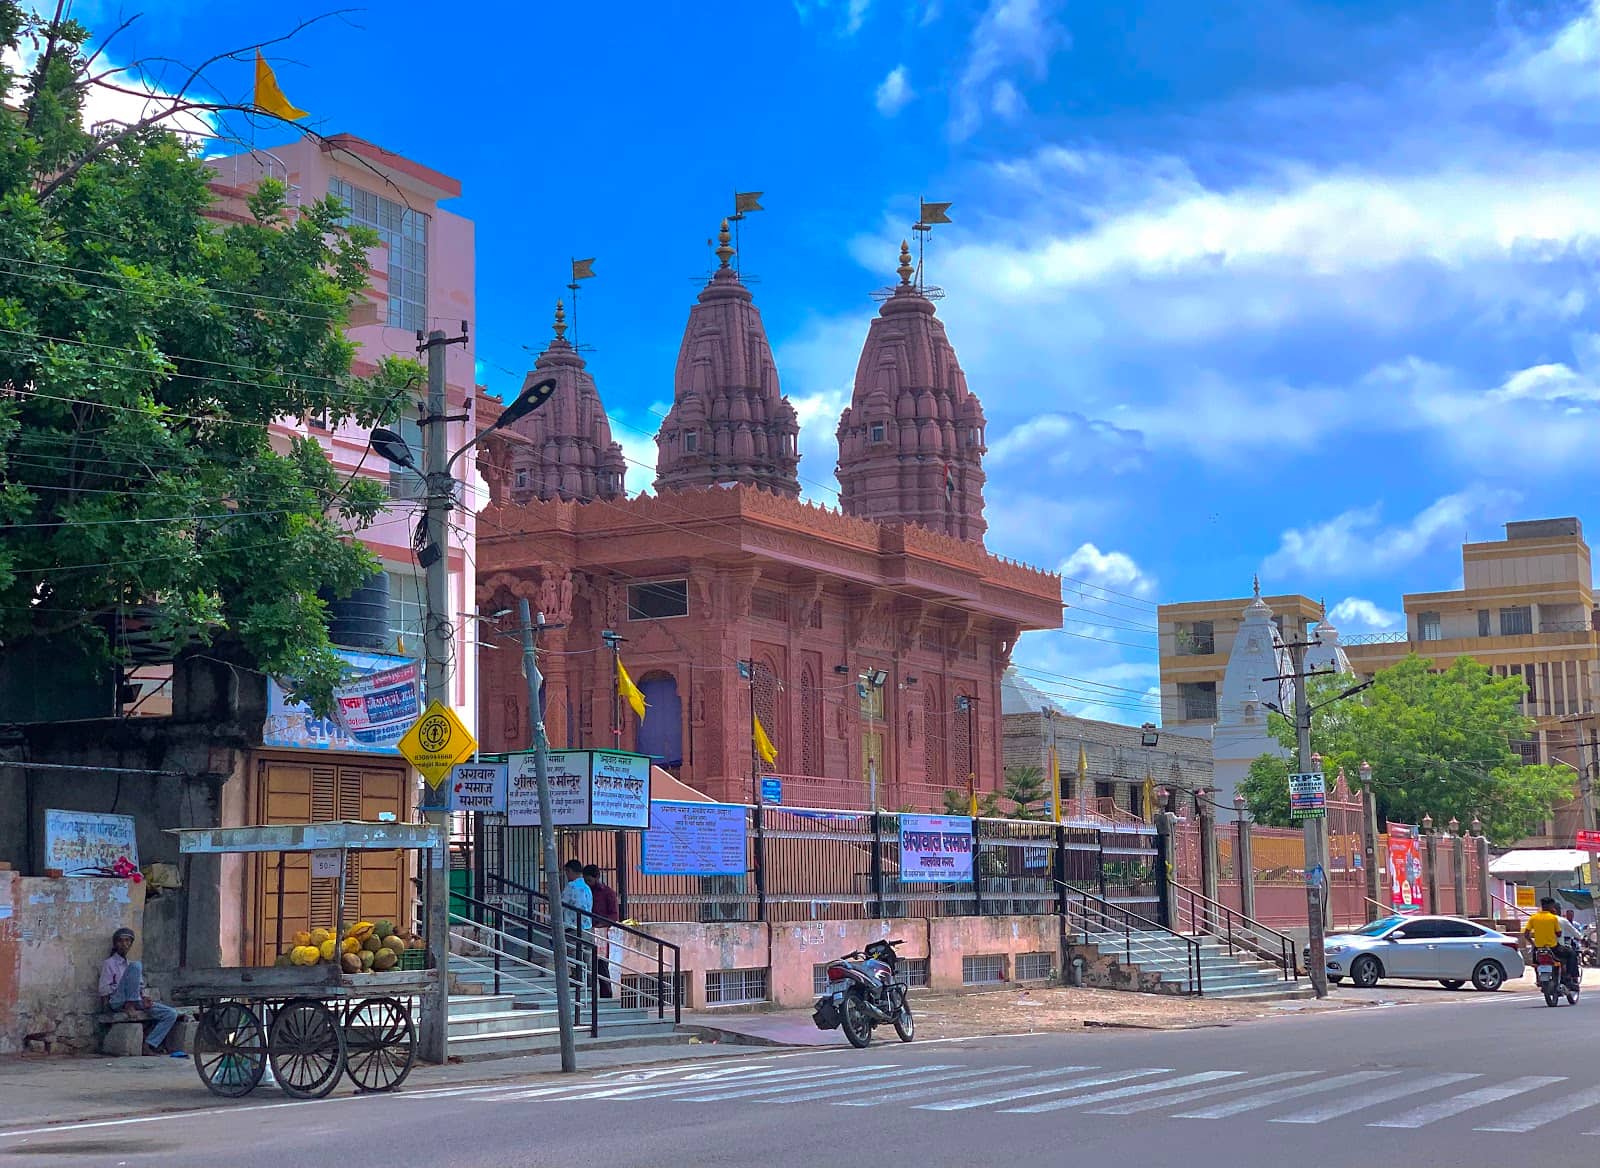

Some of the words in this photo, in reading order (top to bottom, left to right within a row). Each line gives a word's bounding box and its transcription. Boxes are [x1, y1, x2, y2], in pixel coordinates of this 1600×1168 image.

[457, 768, 496, 779] अग्रवाल
[1290, 774, 1322, 782] RPS
[464, 782, 493, 792] समाज
[459, 795, 494, 806] सभागार
[903, 830, 942, 852] अग्रवाल
[942, 832, 971, 852] समाज
[920, 852, 941, 867] मालवीय
[941, 857, 955, 868] नगर
